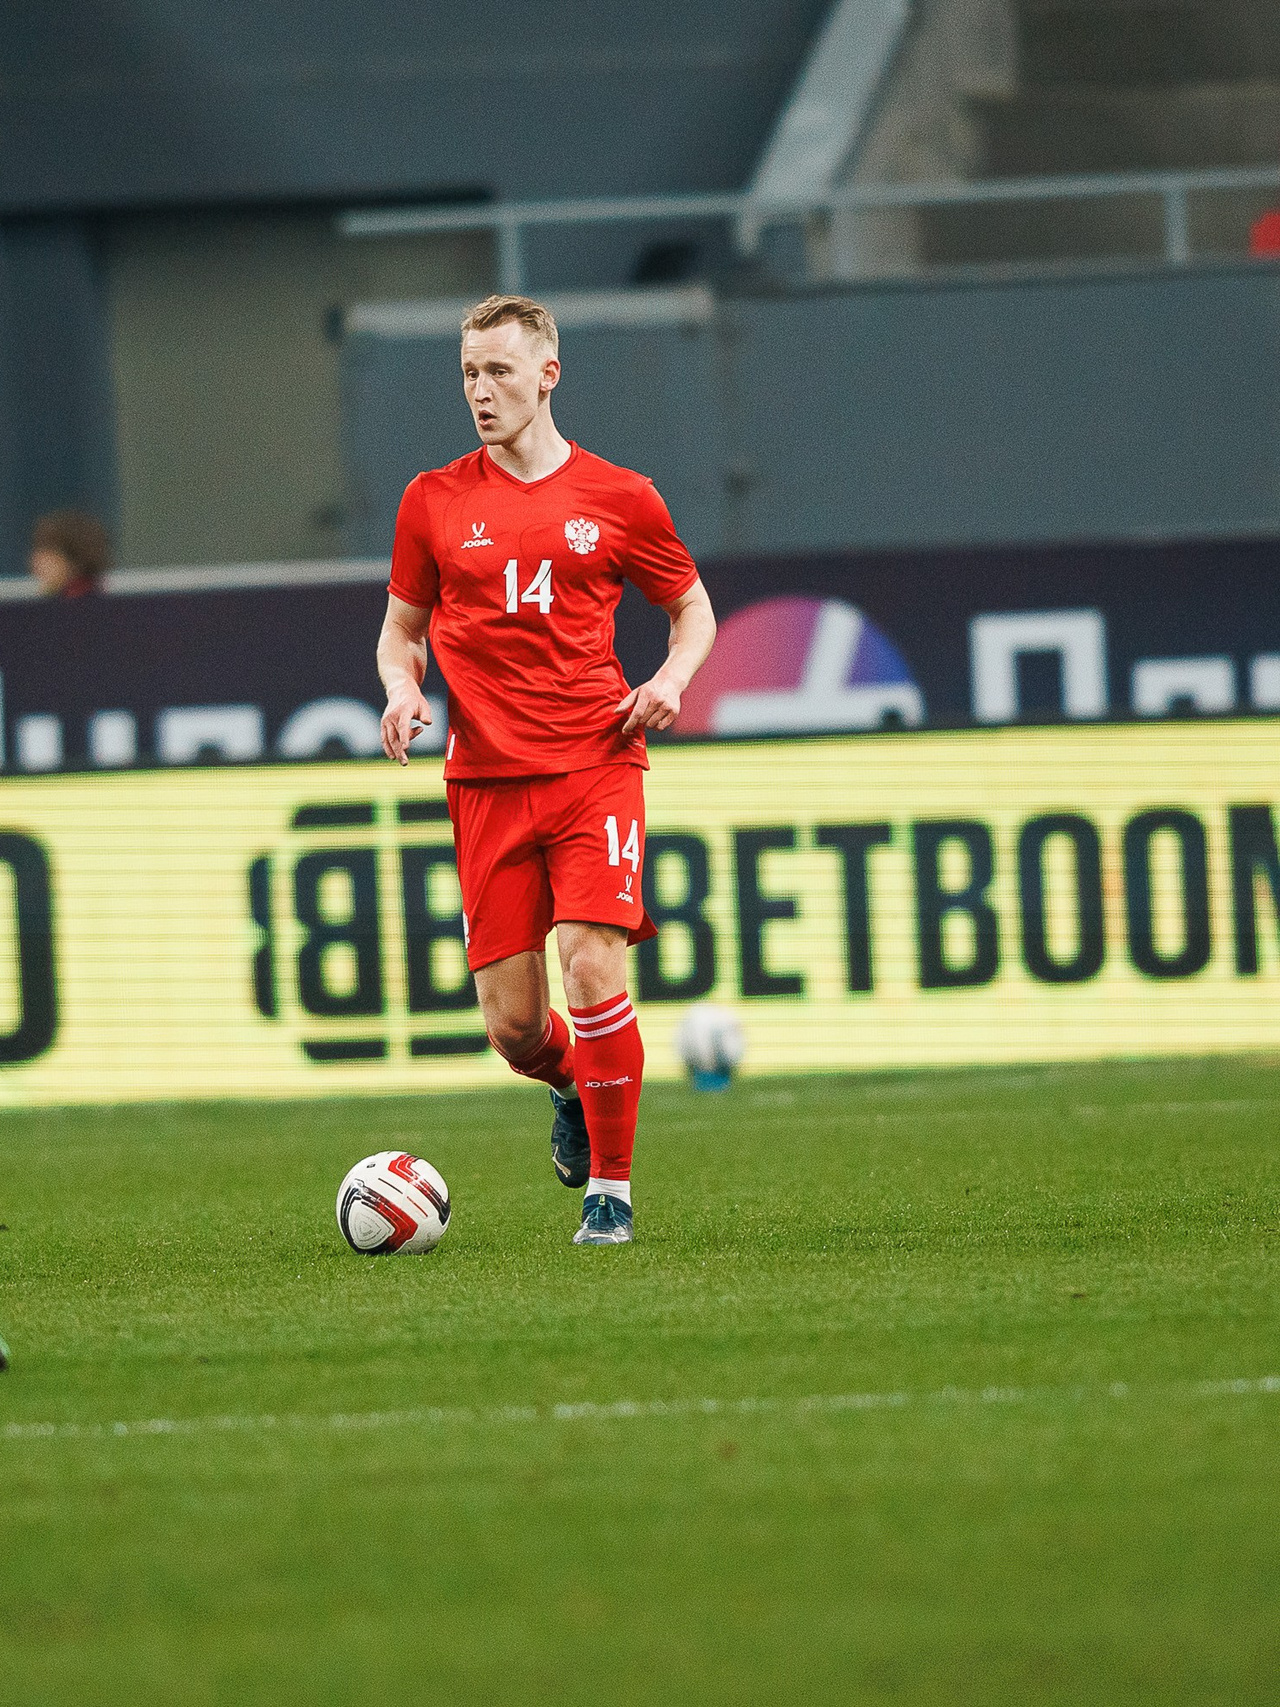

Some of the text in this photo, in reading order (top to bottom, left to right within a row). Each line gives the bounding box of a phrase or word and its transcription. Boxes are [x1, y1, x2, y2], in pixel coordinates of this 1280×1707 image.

[460, 538, 495, 549] JOGEL
[503, 558, 555, 614] 14
[603, 815, 640, 873] 14
